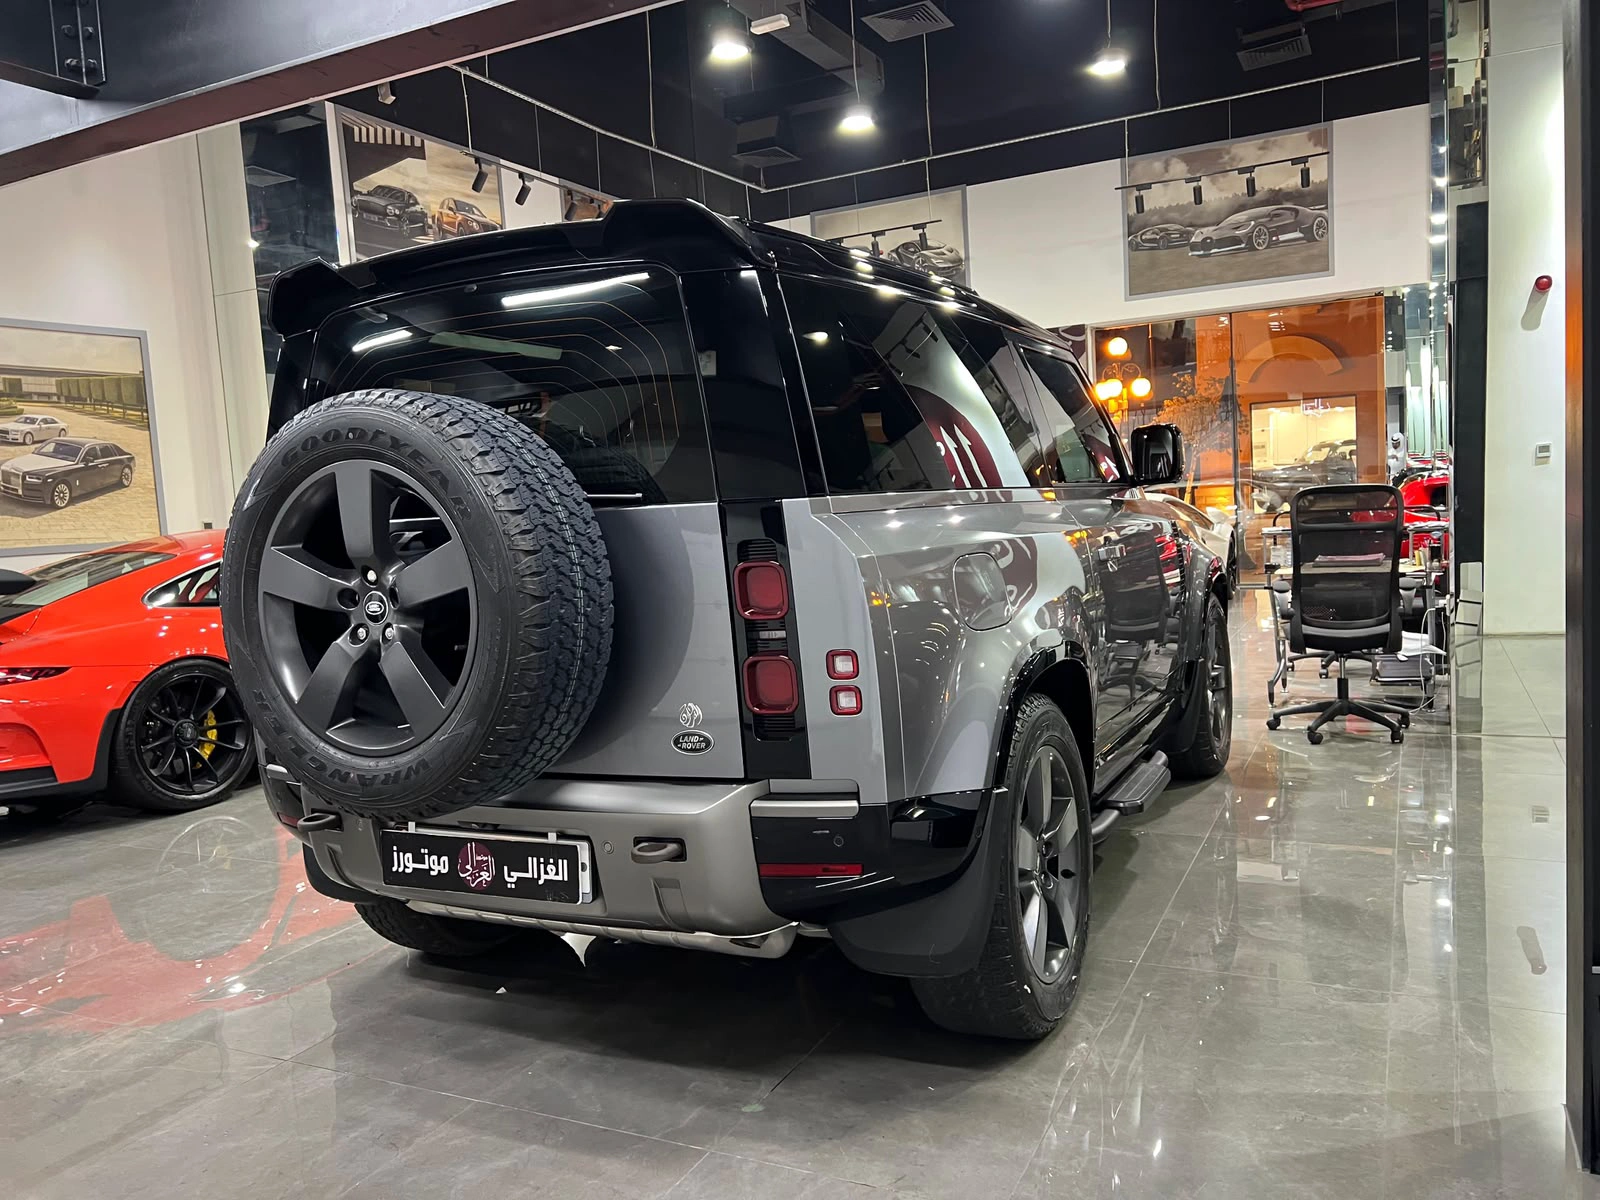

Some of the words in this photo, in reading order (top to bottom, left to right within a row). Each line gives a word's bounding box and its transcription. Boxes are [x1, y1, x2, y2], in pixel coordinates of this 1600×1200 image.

[281, 427, 473, 521] GOODYEAR
[392, 845, 449, 876] موتورز
[503, 856, 568, 888] الغزالي
